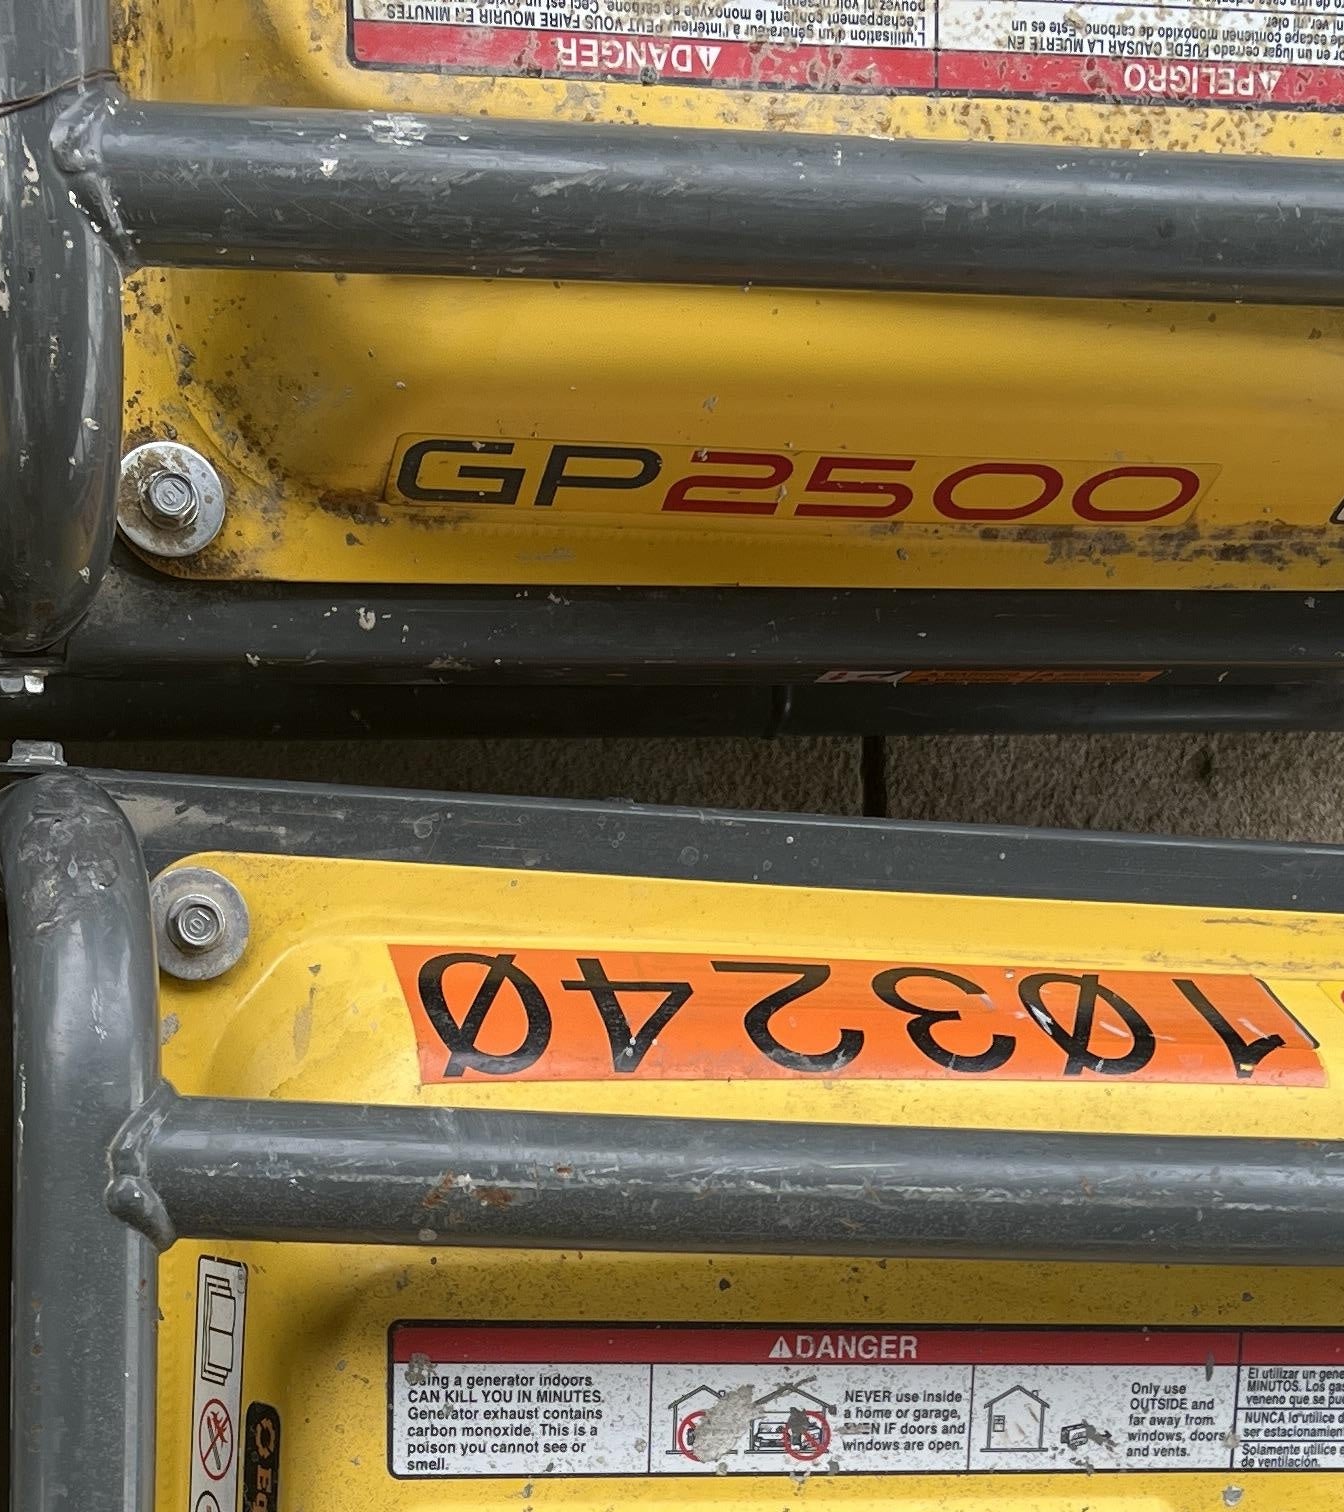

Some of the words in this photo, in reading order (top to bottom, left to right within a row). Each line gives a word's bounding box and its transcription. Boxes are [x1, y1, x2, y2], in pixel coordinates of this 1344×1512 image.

[556, 41, 695, 74] DANGER
[1123, 61, 1270, 96] PELIGRO
[396, 439, 1200, 523] GP2500
[795, 1336, 919, 1359] DANGER
[409, 1374, 448, 1388] sing
[454, 1376, 461, 1386] a
[467, 1375, 534, 1389] generator
[539, 1374, 592, 1386] indoors
[1131, 1382, 1160, 1397] Only
[1164, 1385, 1186, 1394] use
[408, 1390, 439, 1403] CAN
[445, 1390, 477, 1403] KILL
[482, 1390, 512, 1403] YOU
[518, 1390, 531, 1403] IN
[537, 1390, 605, 1403] MINUTES.
[845, 1391, 892, 1402] NEVER
[897, 1393, 919, 1402] use
[923, 1391, 962, 1402] inside
[1130, 1398, 1188, 1410] OUTSIDE
[1191, 1399, 1214, 1410] and
[484, 1407, 538, 1420] exhaust
[543, 1407, 602, 1420] contains
[844, 1409, 850, 1418] a
[856, 1407, 892, 1418] home
[897, 1409, 908, 1418] or
[913, 1409, 960, 1421] garage,
[1129, 1414, 1145, 1425] far
[1149, 1416, 1181, 1428] away
[1185, 1414, 1214, 1425] from
[407, 1424, 456, 1436] carbon
[462, 1424, 534, 1436] monoxide.
[540, 1424, 569, 1436] This
[574, 1424, 586, 1436] is
[590, 1427, 597, 1436] a
[884, 1423, 896, 1434] IF
[901, 1423, 937, 1434] doors
[942, 1423, 965, 1434] and
[1128, 1430, 1185, 1442] windows,
[1190, 1431, 1225, 1441] doors
[407, 1442, 455, 1454] poison
[460, 1443, 486, 1456] you
[491, 1441, 538, 1454] cannot
[543, 1443, 567, 1453] see
[572, 1443, 586, 1453] or
[842, 1439, 900, 1451] windows
[904, 1442, 924, 1450] are
[928, 1441, 963, 1452] open.
[1127, 1445, 1149, 1456] and
[1153, 1446, 1190, 1456] vents.
[407, 1459, 449, 1471] smell.
